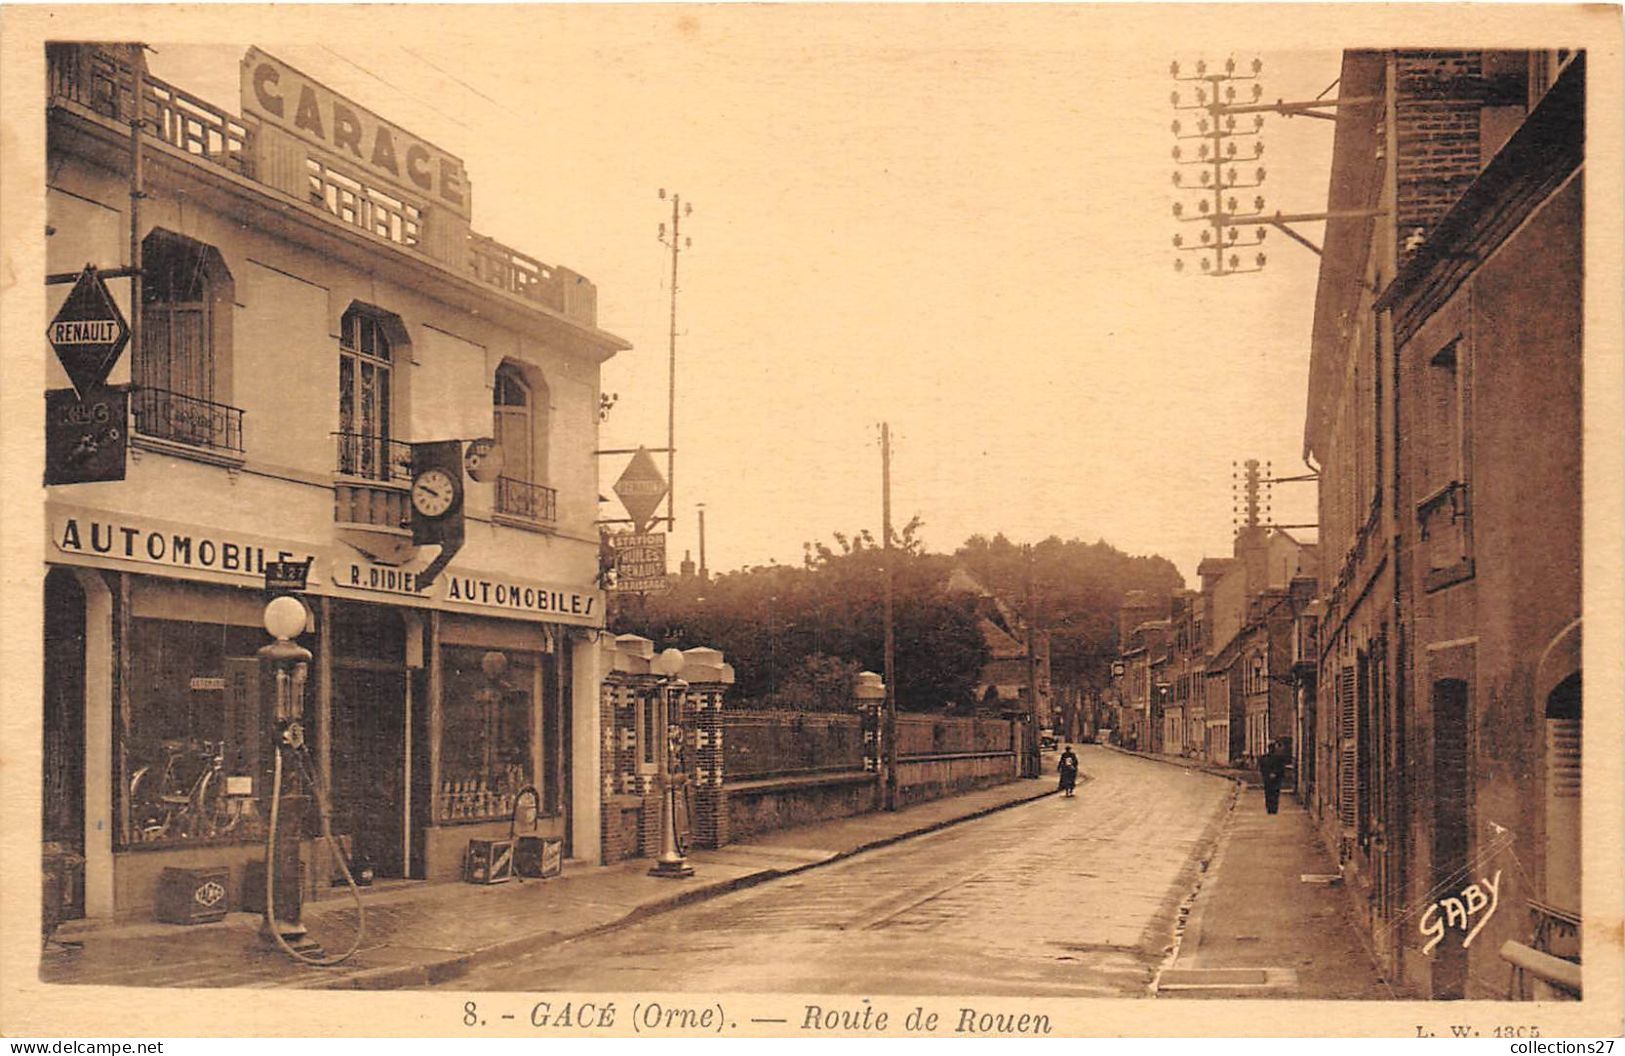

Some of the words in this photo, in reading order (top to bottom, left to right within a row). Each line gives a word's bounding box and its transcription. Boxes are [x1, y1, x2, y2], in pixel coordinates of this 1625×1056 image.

[253, 62, 464, 207] GARAGE
[56, 323, 115, 342] RENAULT
[615, 534, 664, 547] STATION
[450, 577, 593, 615] AUTOMOBILES
